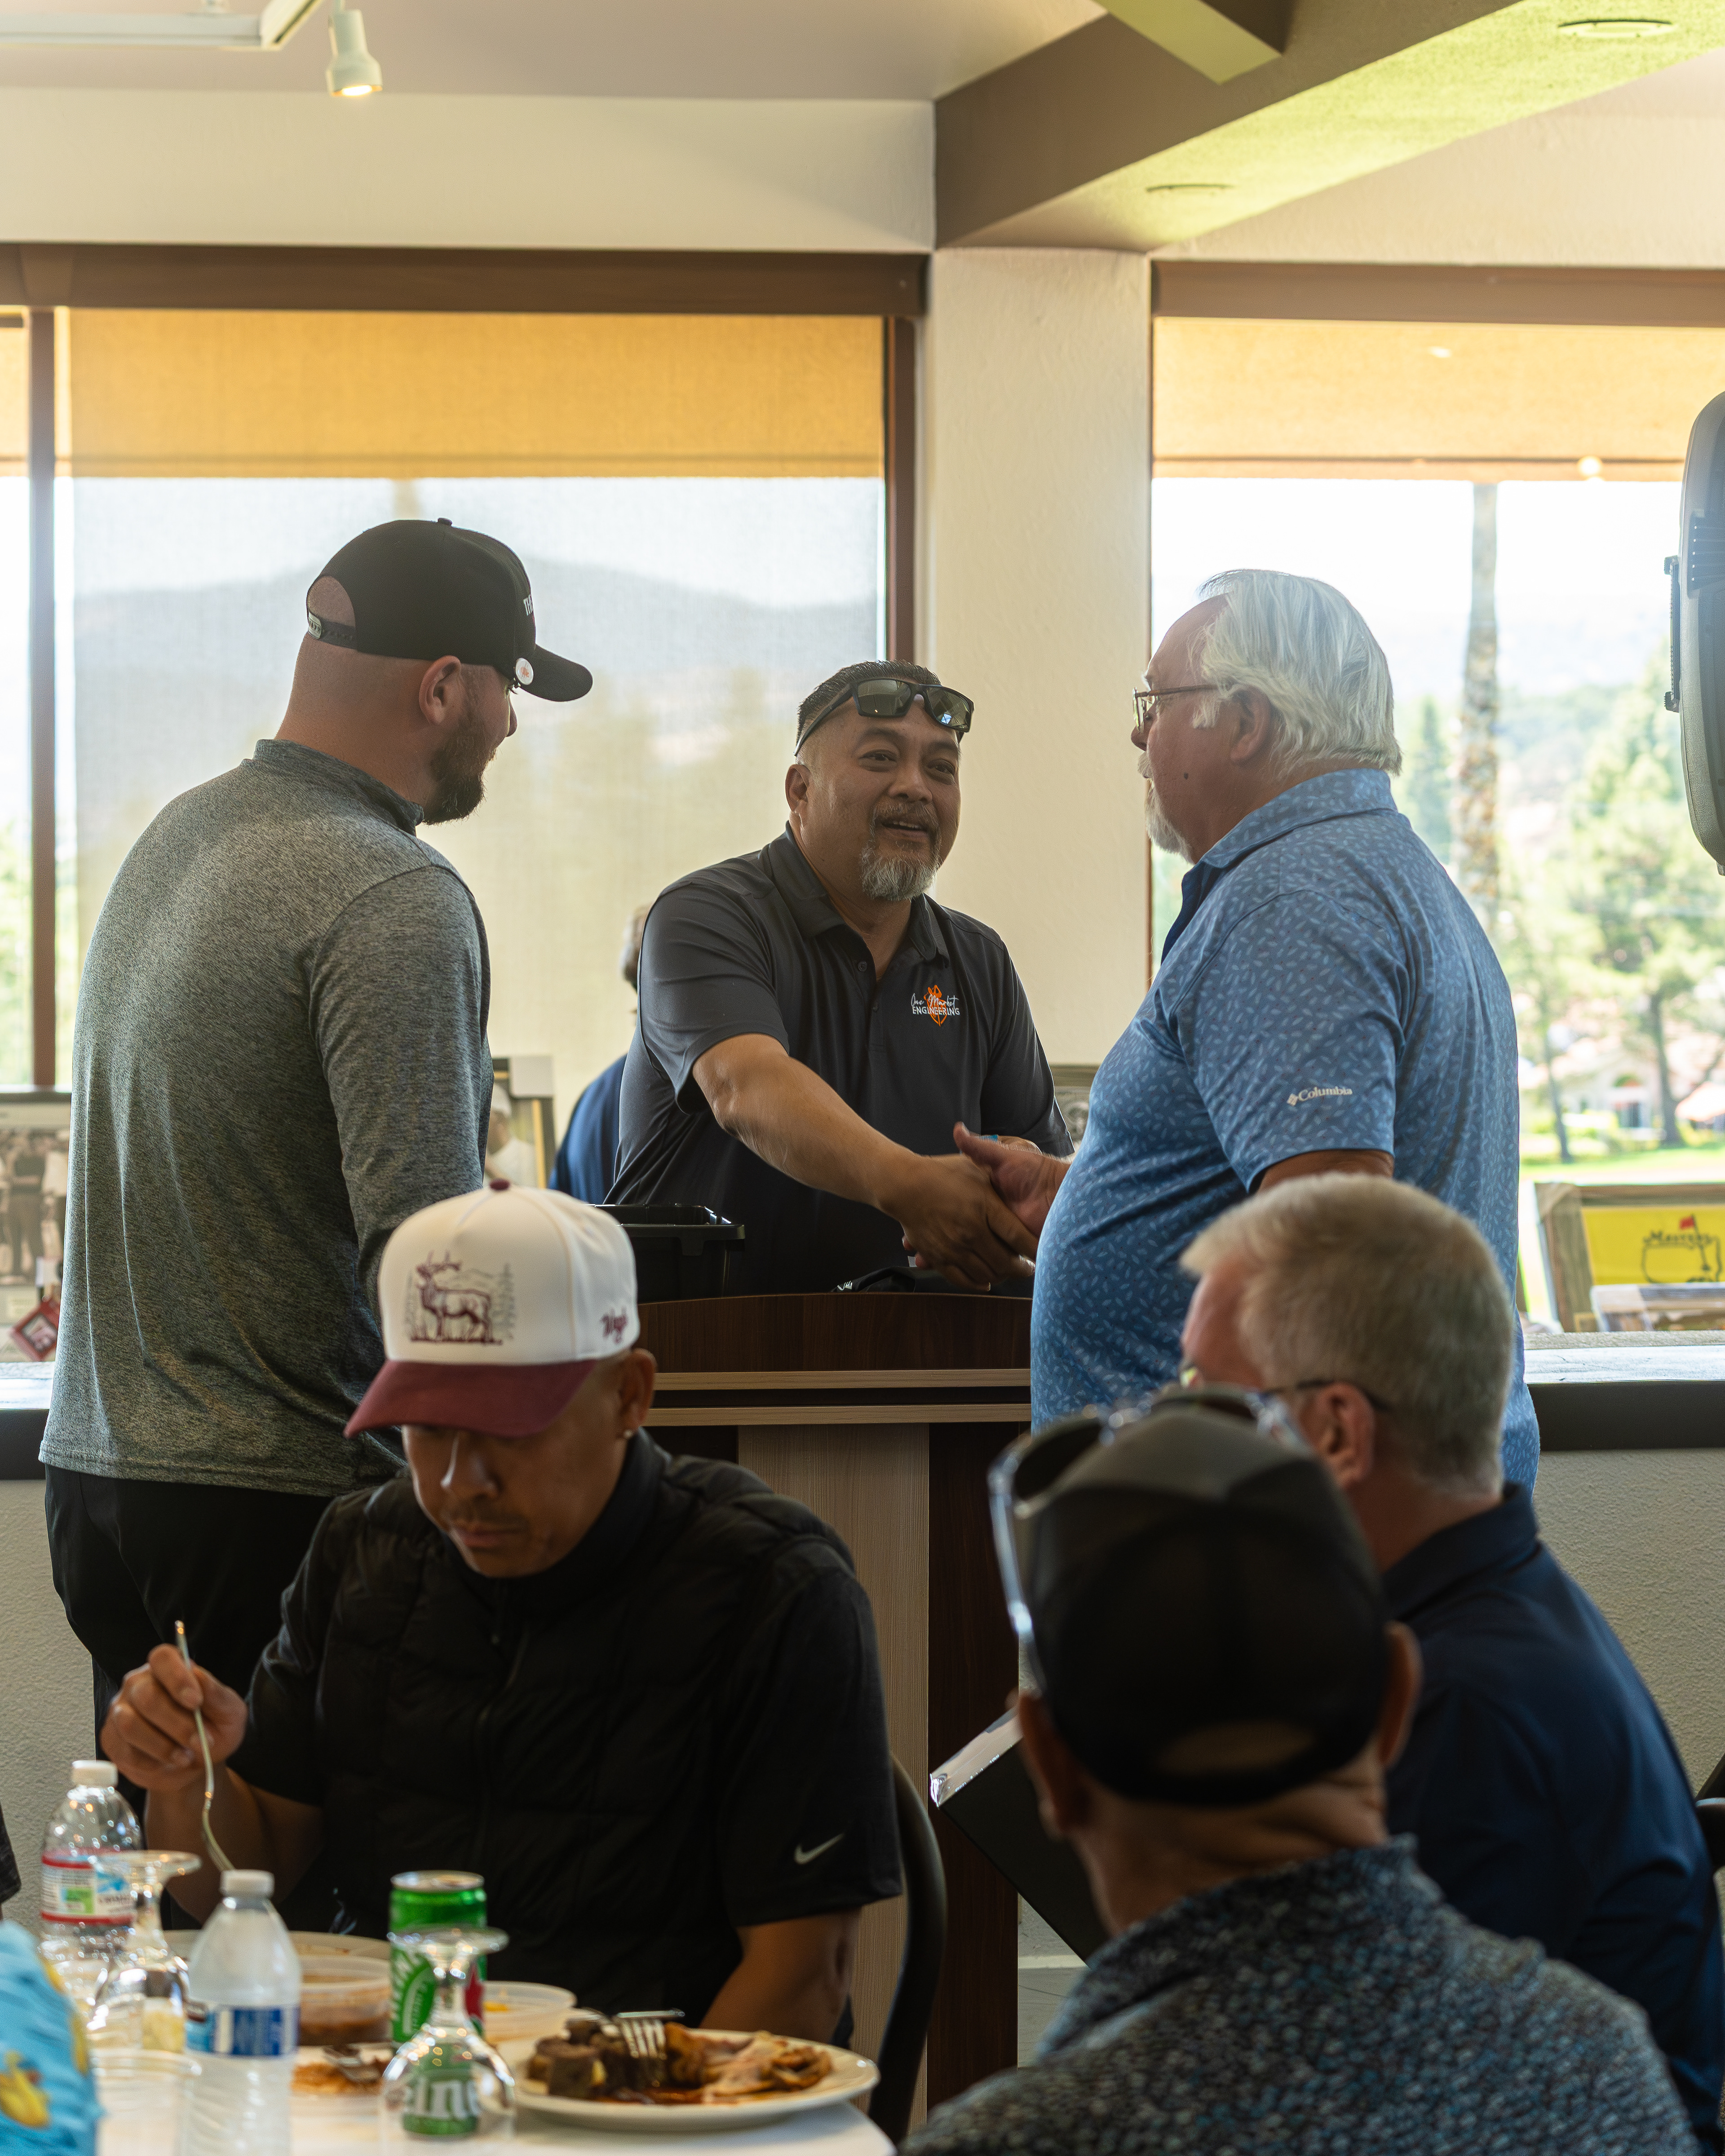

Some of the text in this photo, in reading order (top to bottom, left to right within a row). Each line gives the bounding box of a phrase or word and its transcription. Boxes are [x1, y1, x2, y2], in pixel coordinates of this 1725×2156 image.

[911, 993, 959, 1009] One Market
[912, 1006, 960, 1016] ENGINEERING
[1299, 1086, 1353, 1101] Columbia
